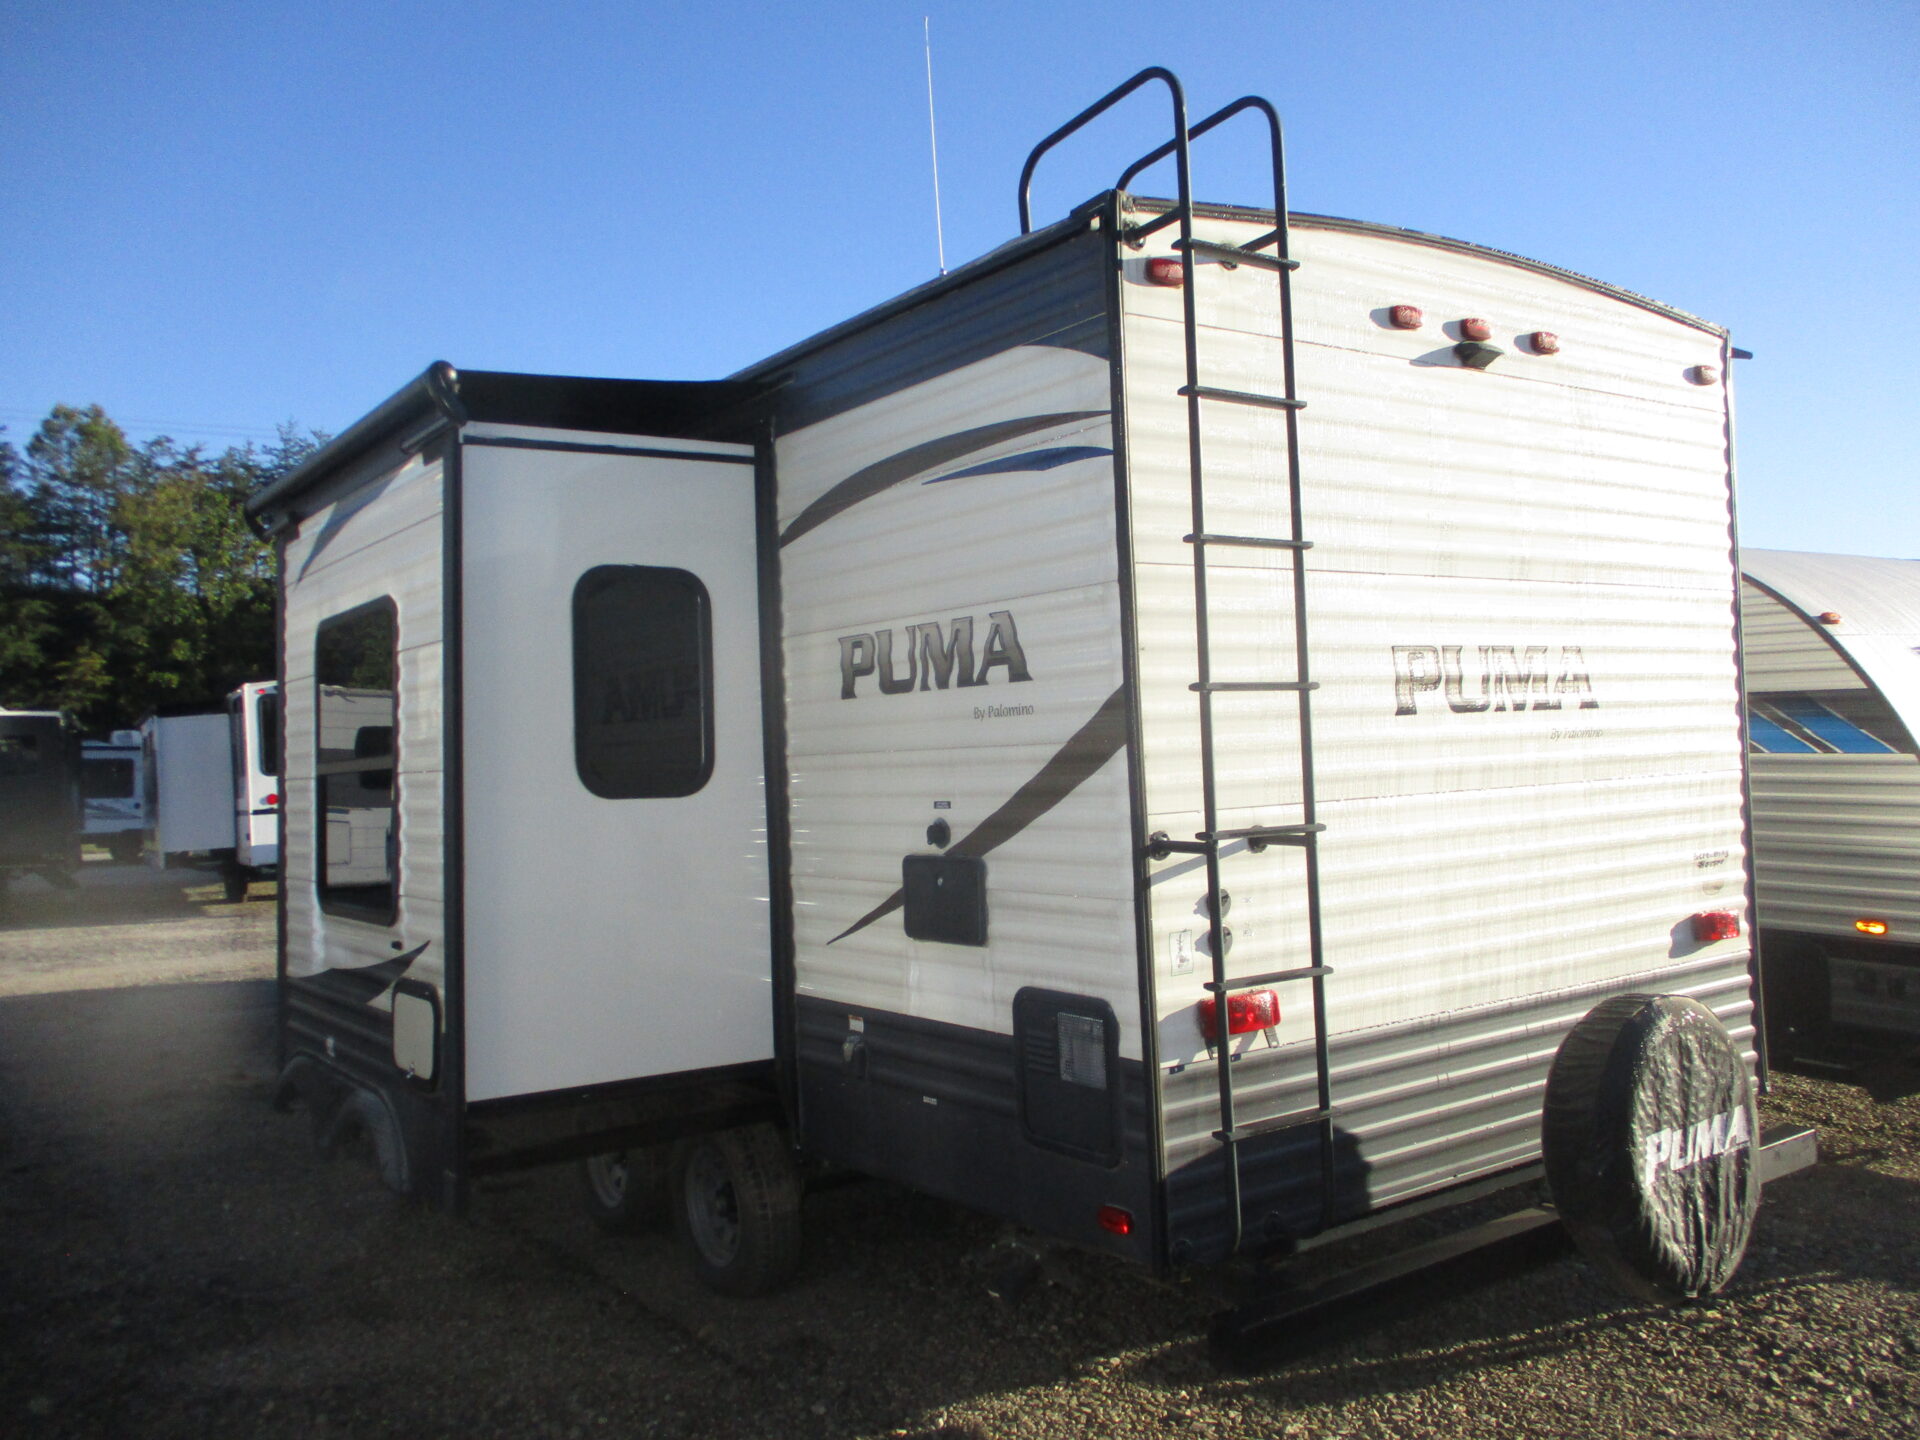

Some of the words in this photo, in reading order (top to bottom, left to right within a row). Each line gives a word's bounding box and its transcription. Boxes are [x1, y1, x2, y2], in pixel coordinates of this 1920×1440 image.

[838, 610, 1033, 699] PUMA
[1391, 645, 1599, 715] PUMA
[973, 707, 986, 720] By
[987, 704, 1034, 718] Palomino
[1645, 1104, 1751, 1187] PUMA
